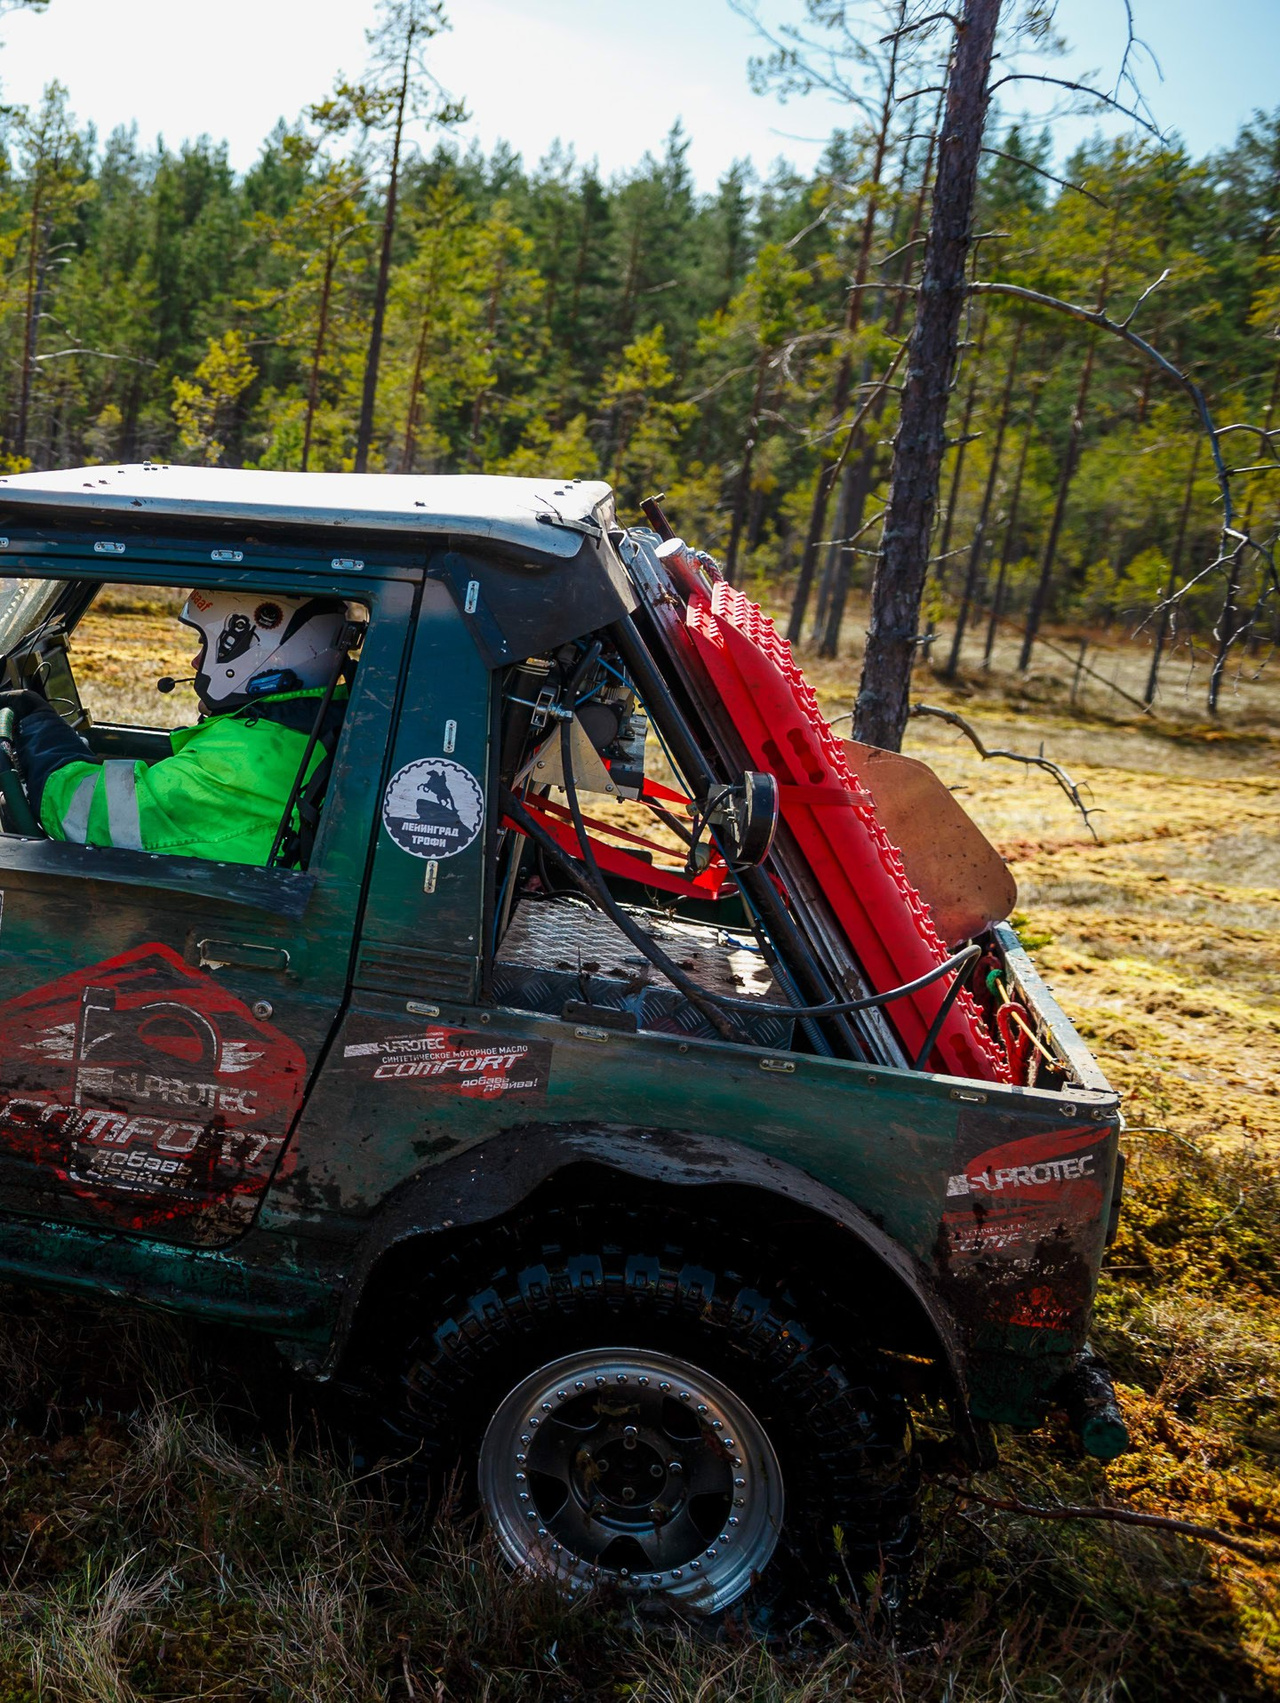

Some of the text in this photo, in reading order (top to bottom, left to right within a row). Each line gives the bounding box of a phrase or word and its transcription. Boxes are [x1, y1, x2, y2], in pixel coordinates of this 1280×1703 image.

[401, 822, 459, 837] ЛЕНИНГРАД
[412, 835, 447, 848] ТРОФИ
[381, 1045, 529, 1064] СИНТЕТИЧЕСКОЕ МОТОРНОЕ МАСЛО
[373, 1053, 524, 1078] COMFORT
[970, 1154, 1096, 1191] SUPROTEC
